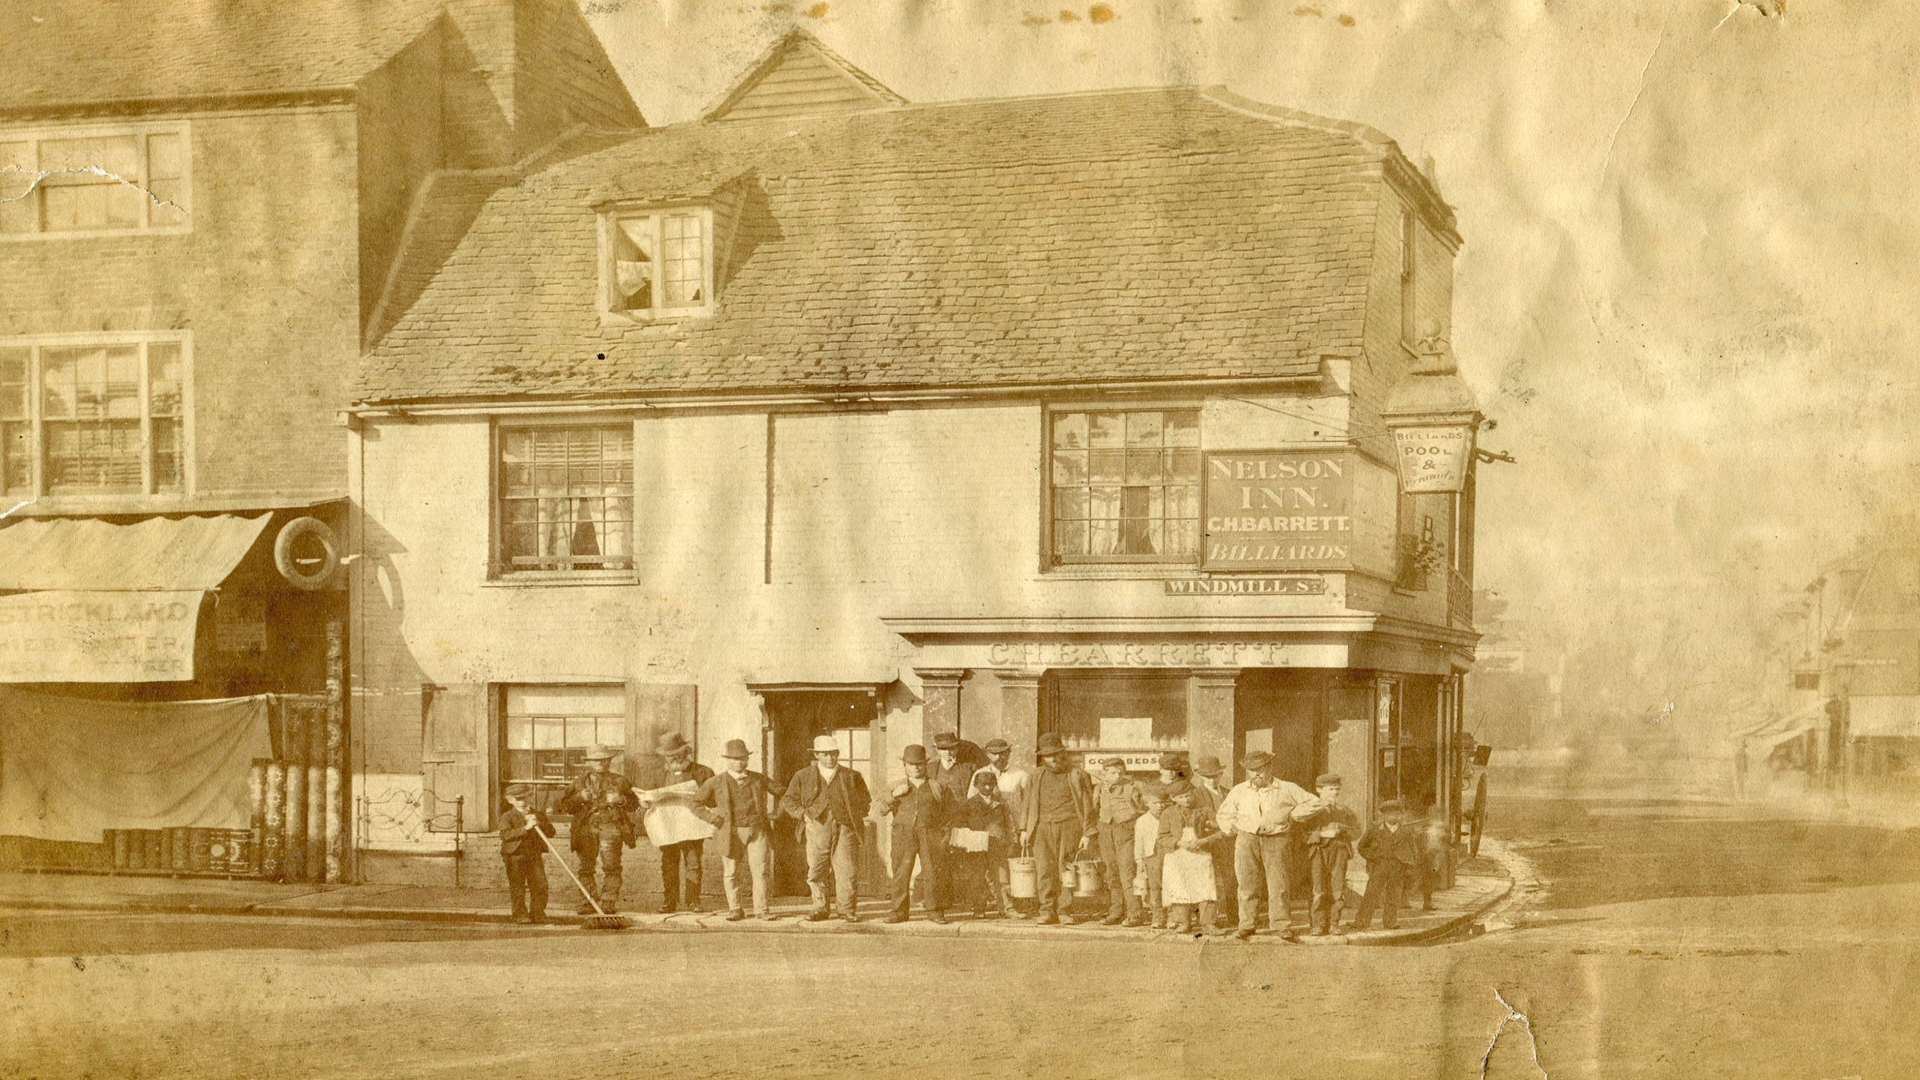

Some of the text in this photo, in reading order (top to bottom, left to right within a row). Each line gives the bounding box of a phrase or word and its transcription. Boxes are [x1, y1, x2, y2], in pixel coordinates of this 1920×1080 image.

[1405, 446, 1452, 456] POOL
[1210, 458, 1344, 480] NELSON
[1422, 459, 1435, 470] &
[1210, 544, 1348, 560] BILLIARDS
[1168, 579, 1287, 593] WINDMILL
